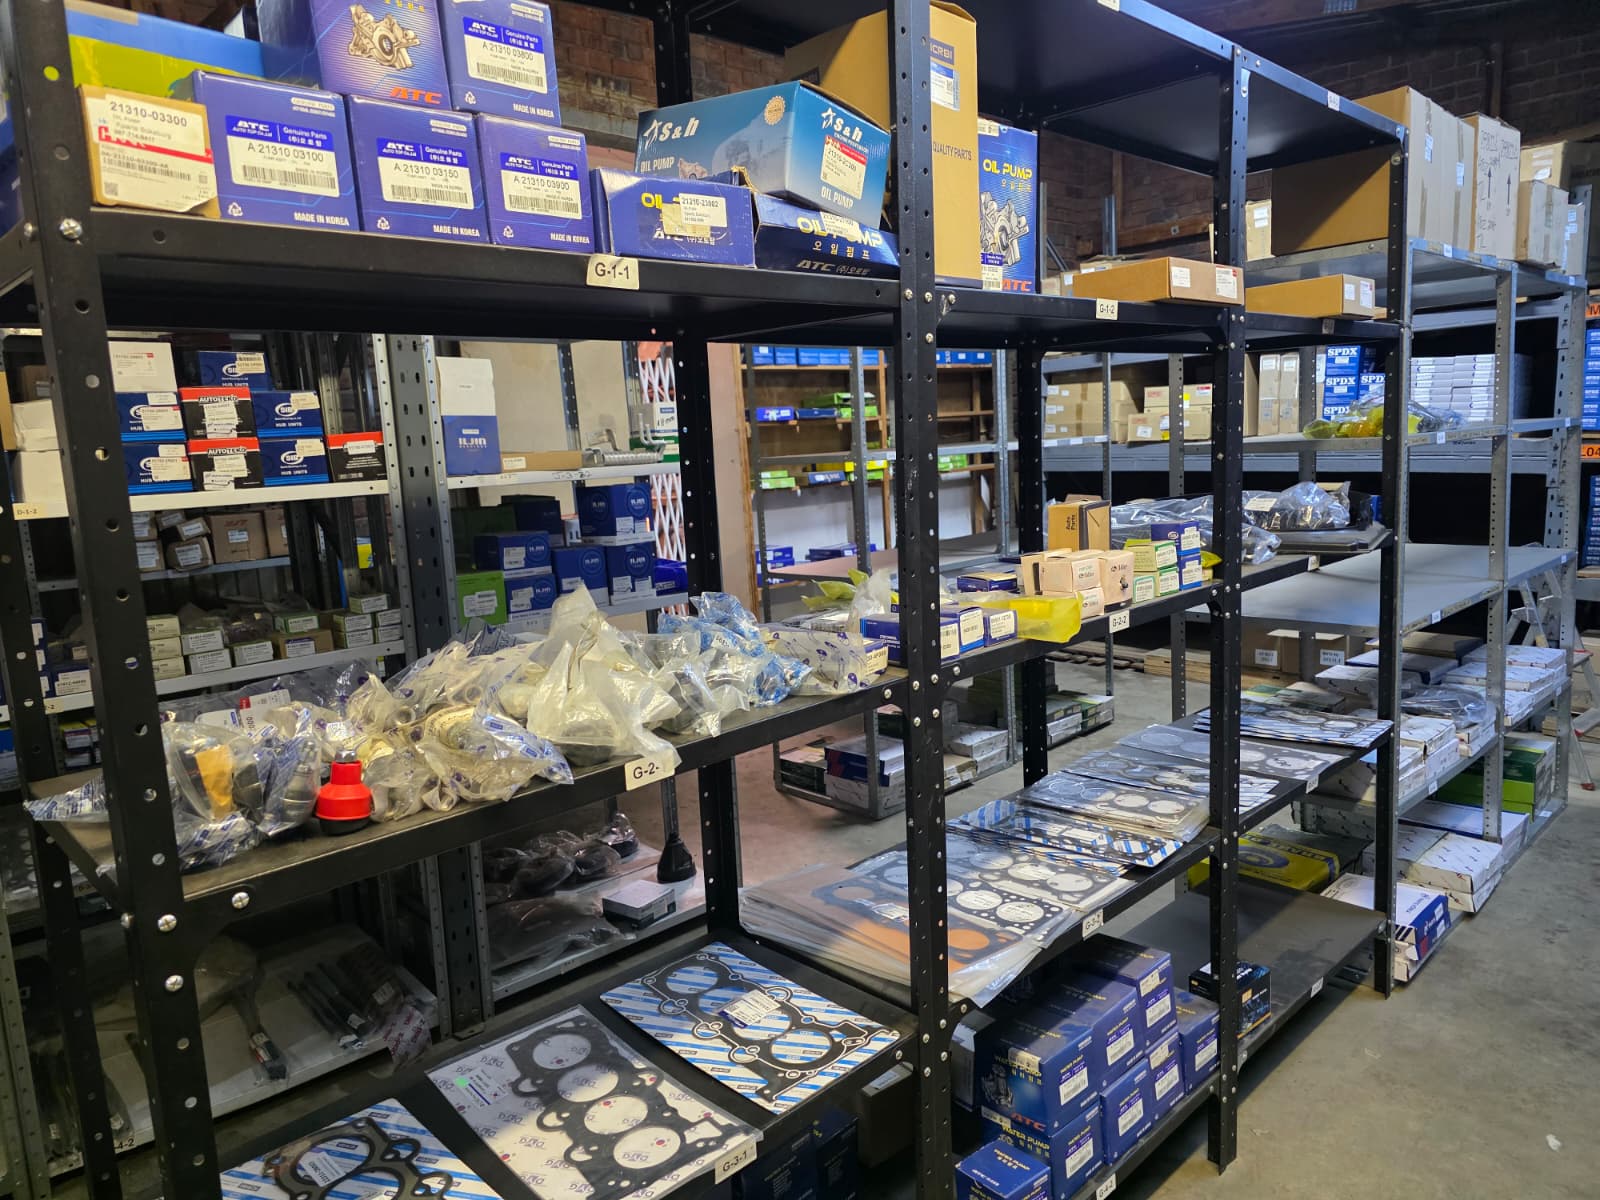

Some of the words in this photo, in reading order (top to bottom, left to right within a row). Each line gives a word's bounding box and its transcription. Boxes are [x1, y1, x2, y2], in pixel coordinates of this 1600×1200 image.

[472, 22, 496, 33] ATC
[482, 41, 489, 50] A
[490, 43, 511, 56] 21310
[512, 50, 534, 61] 03800
[389, 87, 442, 105] ATC
[110, 101, 188, 127] 21310-03300
[513, 103, 529, 113] MADE
[529, 106, 536, 115] IN
[536, 108, 554, 118] KOREA
[237, 120, 270, 132] ATC
[283, 126, 309, 137] Genuine
[311, 131, 328, 140] Parts
[247, 143, 256, 153] A
[258, 144, 290, 157] 21310
[293, 151, 324, 162] 03100
[386, 142, 414, 152] ATC
[932, 142, 953, 157] QUALITY
[954, 147, 972, 161] PARTS
[508, 156, 532, 166] ATC
[641, 160, 652, 173] OIL
[653, 156, 675, 171] PUMP
[394, 163, 401, 172] A
[403, 164, 430, 175] 21310
[433, 168, 459, 179] 03150
[983, 159, 1000, 174] OIL
[1003, 162, 1033, 180] PUMP
[513, 176, 521, 184] A
[522, 177, 545, 187] 21310
[547, 181, 570, 191] 03900
[821, 186, 832, 201] OIL
[833, 192, 854, 209] PUMP
[294, 212, 316, 223] MADE
[316, 214, 325, 223] IN
[326, 215, 350, 226] KOREA
[433, 224, 452, 234] MADE
[452, 227, 459, 235] IN
[460, 227, 480, 237] KOREA
[551, 233, 566, 242] MADE
[572, 235, 590, 244] KOREA
[595, 262, 630, 279] G-1-1
[796, 260, 835, 272] ATC
[1002, 278, 1032, 292] ATC
[1099, 304, 1115, 314] G-1-2
[1328, 348, 1358, 356] SPDX
[1326, 376, 1356, 386] SPDX
[1361, 375, 1385, 384] SPD
[1112, 615, 1128, 627] G-2-2
[633, 762, 660, 779] G-2-
[1010, 1112, 1047, 1132] ATC
[723, 1152, 748, 1172] G-3-1
